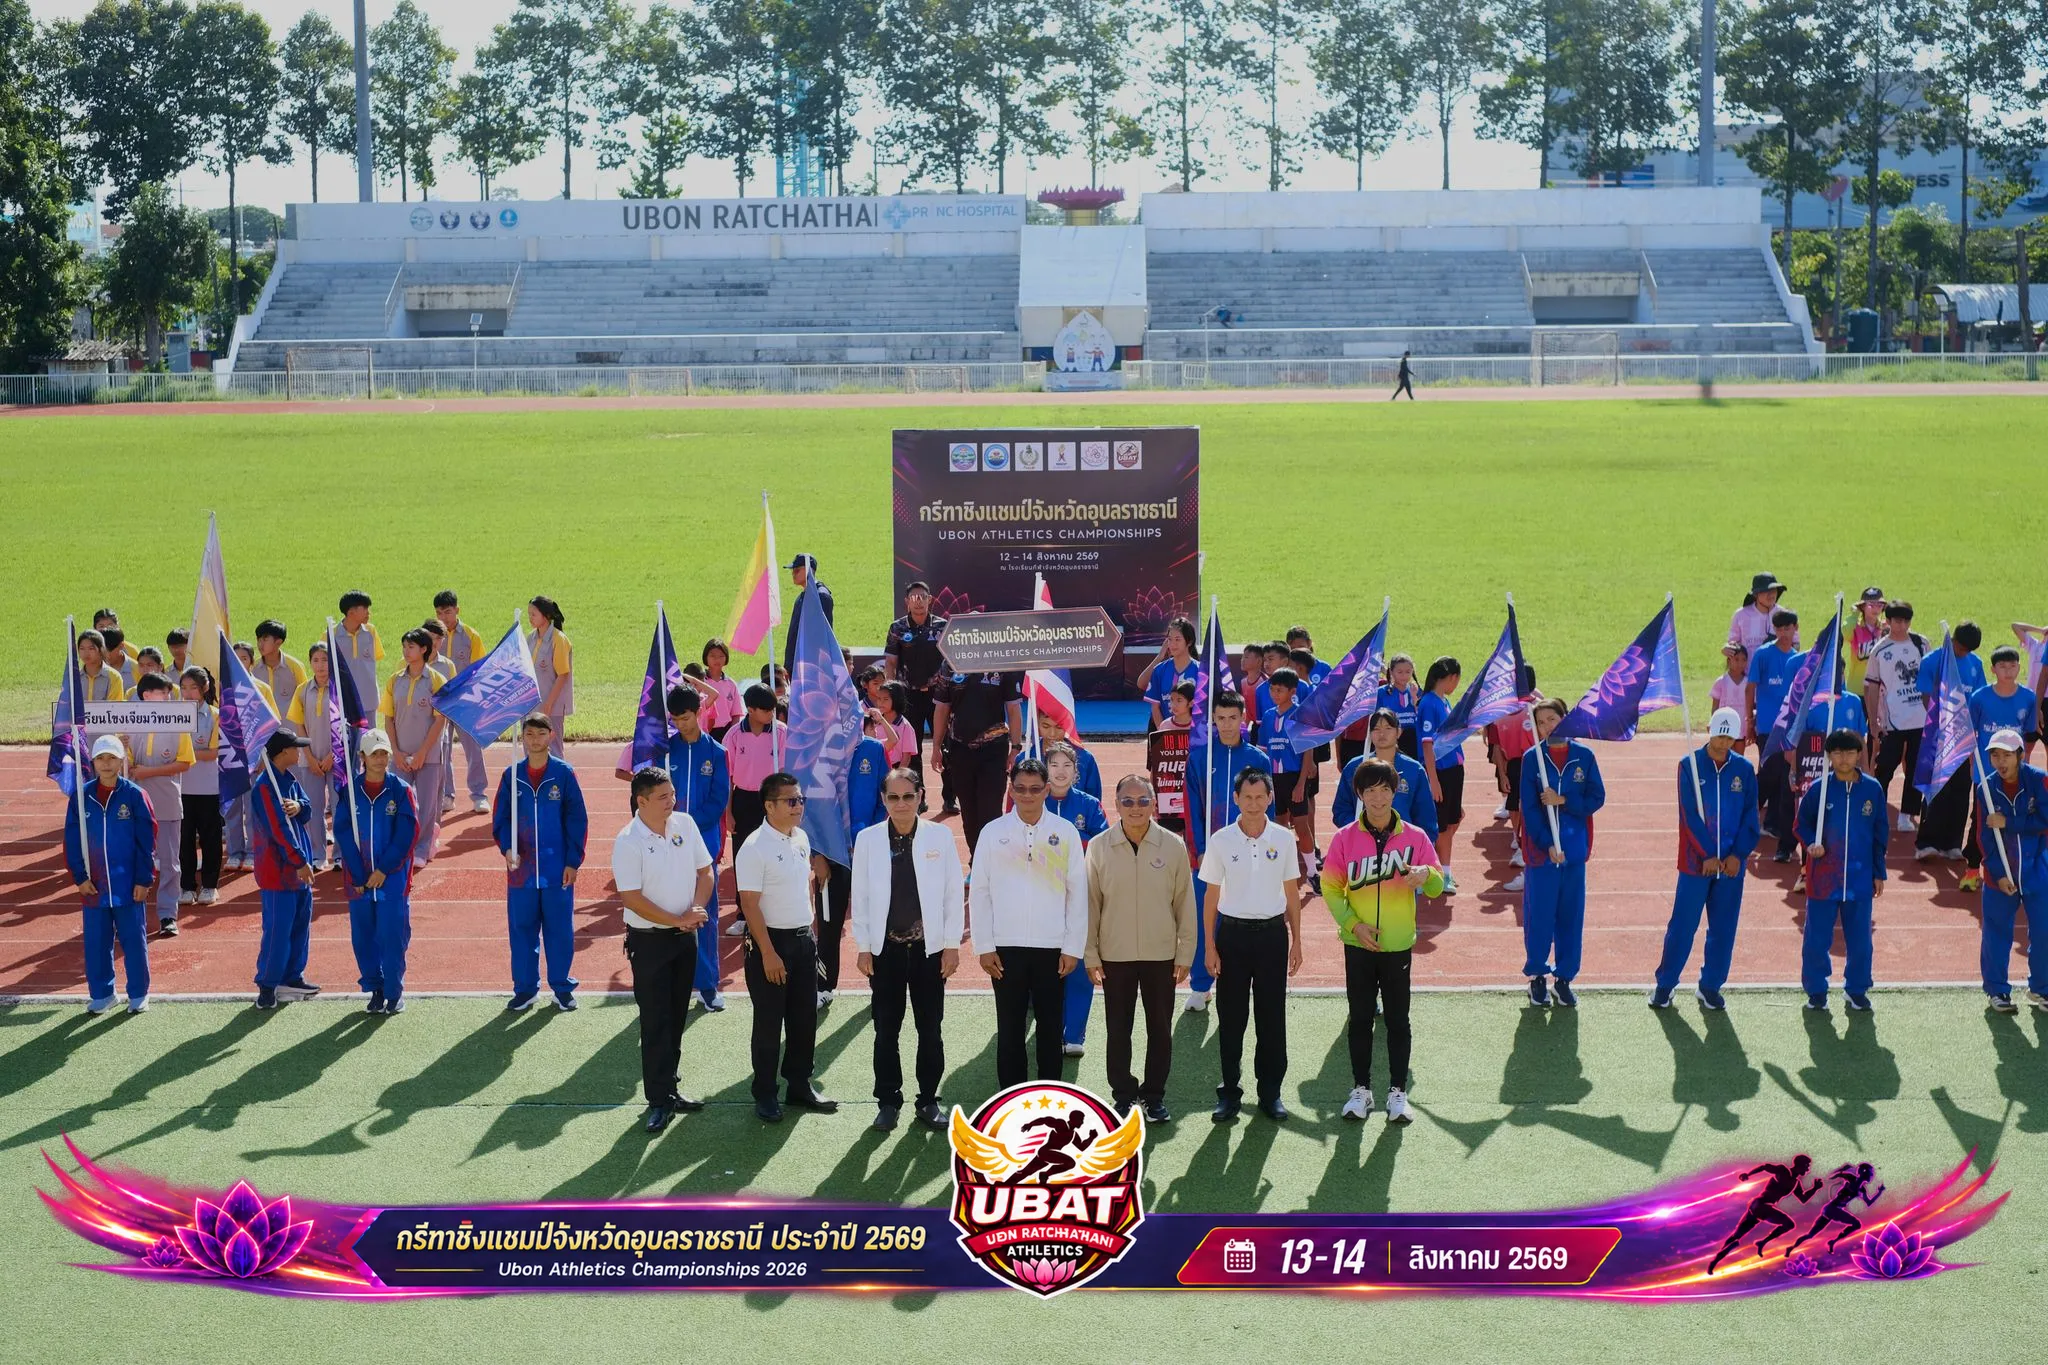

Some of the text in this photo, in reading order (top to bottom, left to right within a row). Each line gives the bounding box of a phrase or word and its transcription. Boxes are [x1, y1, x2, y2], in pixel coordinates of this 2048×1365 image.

[622, 204, 701, 230] UBON
[956, 204, 1018, 217] HOSPITAL
[919, 496, 1178, 527] กรีฑาชิงแชมป์จังหวัดอุบลราชธานี
[938, 528, 1162, 540] UBON ATHLETICS CHAMPIONSHIPS
[1000, 552, 1010, 561] 12
[1022, 552, 1032, 561] 14
[1036, 551, 1073, 561] สิงหาคม
[1076, 552, 1099, 561] 2569
[947, 620, 1105, 647] กรีฑาชิงแชมป์จังหวัดอุบลราชธานี
[955, 645, 1102, 660] UBON ATHLETICS CHAMPIONSHIPS
[84, 710, 191, 725] รียนโขงเจียมวิทยาคม
